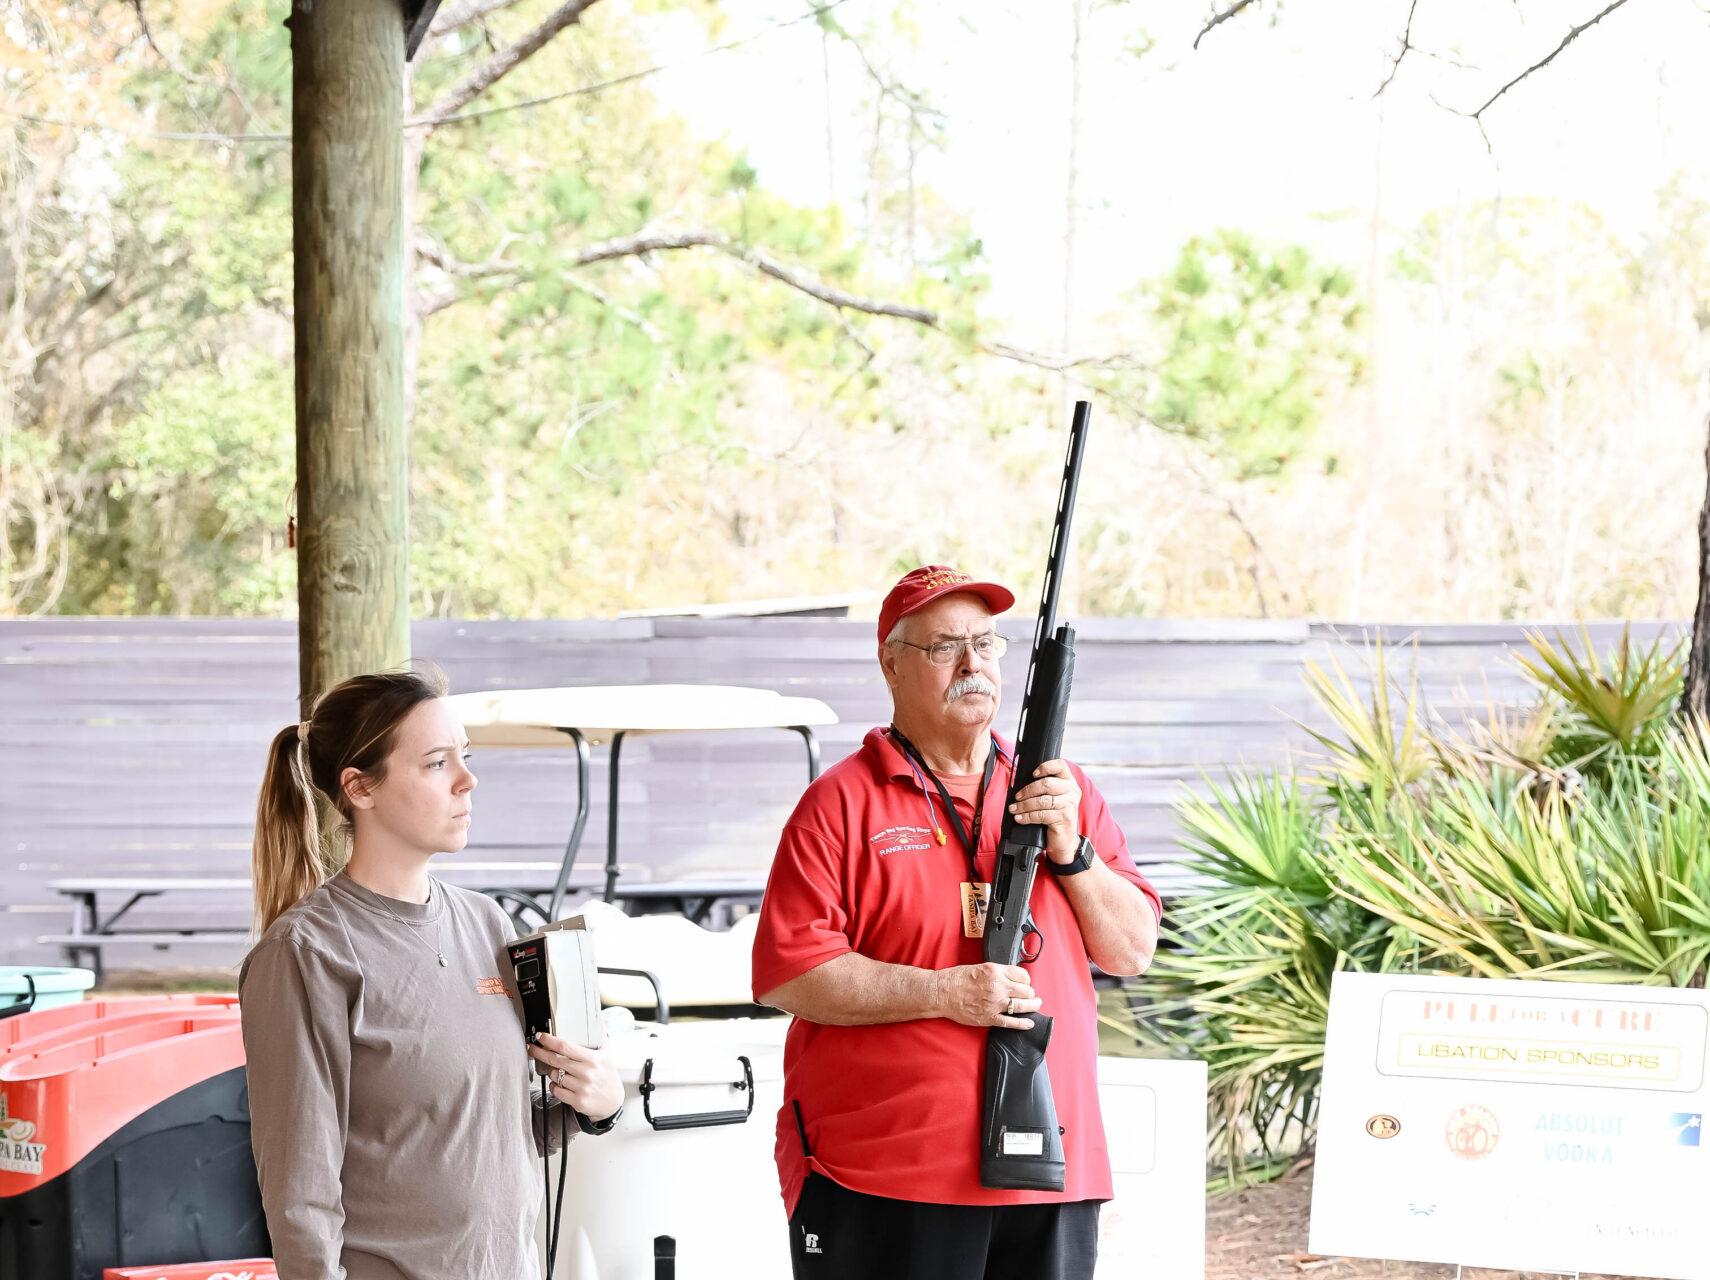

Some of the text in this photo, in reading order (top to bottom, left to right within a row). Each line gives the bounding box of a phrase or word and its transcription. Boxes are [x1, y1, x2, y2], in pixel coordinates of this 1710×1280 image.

[880, 843, 931, 856] RANGE OFFICER
[1417, 1043, 1660, 1070] LIBATION SPONSORS
[1535, 1112, 1624, 1137] ABSOLUT
[14, 1143, 44, 1162] BAY
[1543, 1142, 1614, 1165] VODKA
